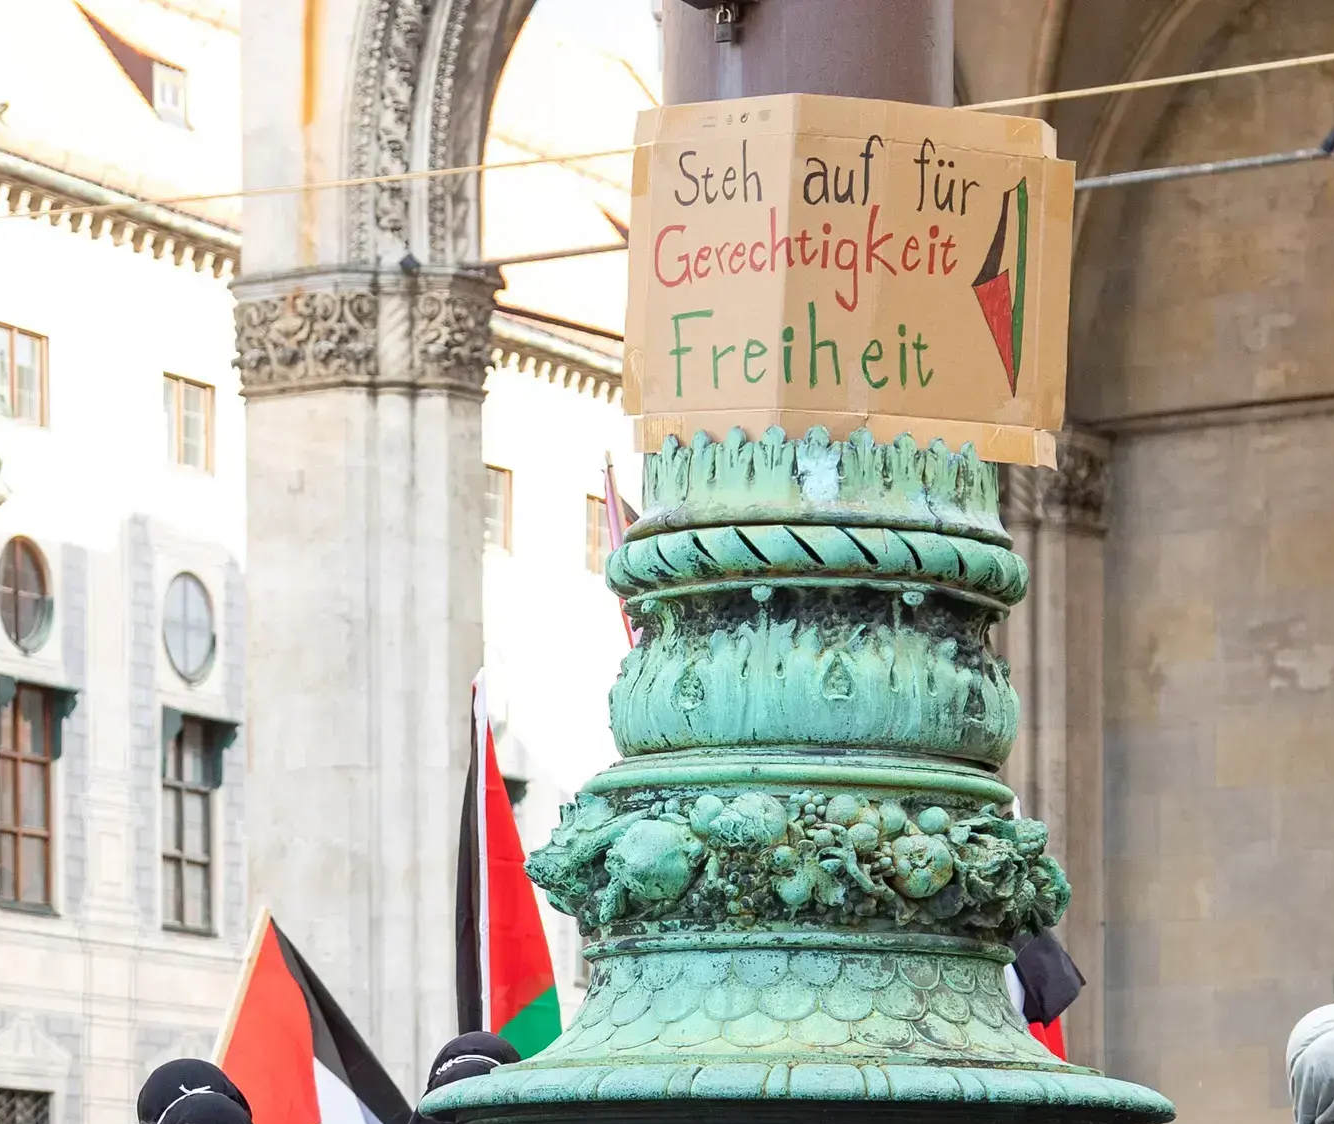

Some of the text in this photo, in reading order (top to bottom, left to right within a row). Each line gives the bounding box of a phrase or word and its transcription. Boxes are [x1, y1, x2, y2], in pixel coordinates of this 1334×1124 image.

[673, 134, 980, 216] Steh auf für
[653, 204, 959, 312] Gerechtigkeit
[668, 301, 935, 398] Freiheit
